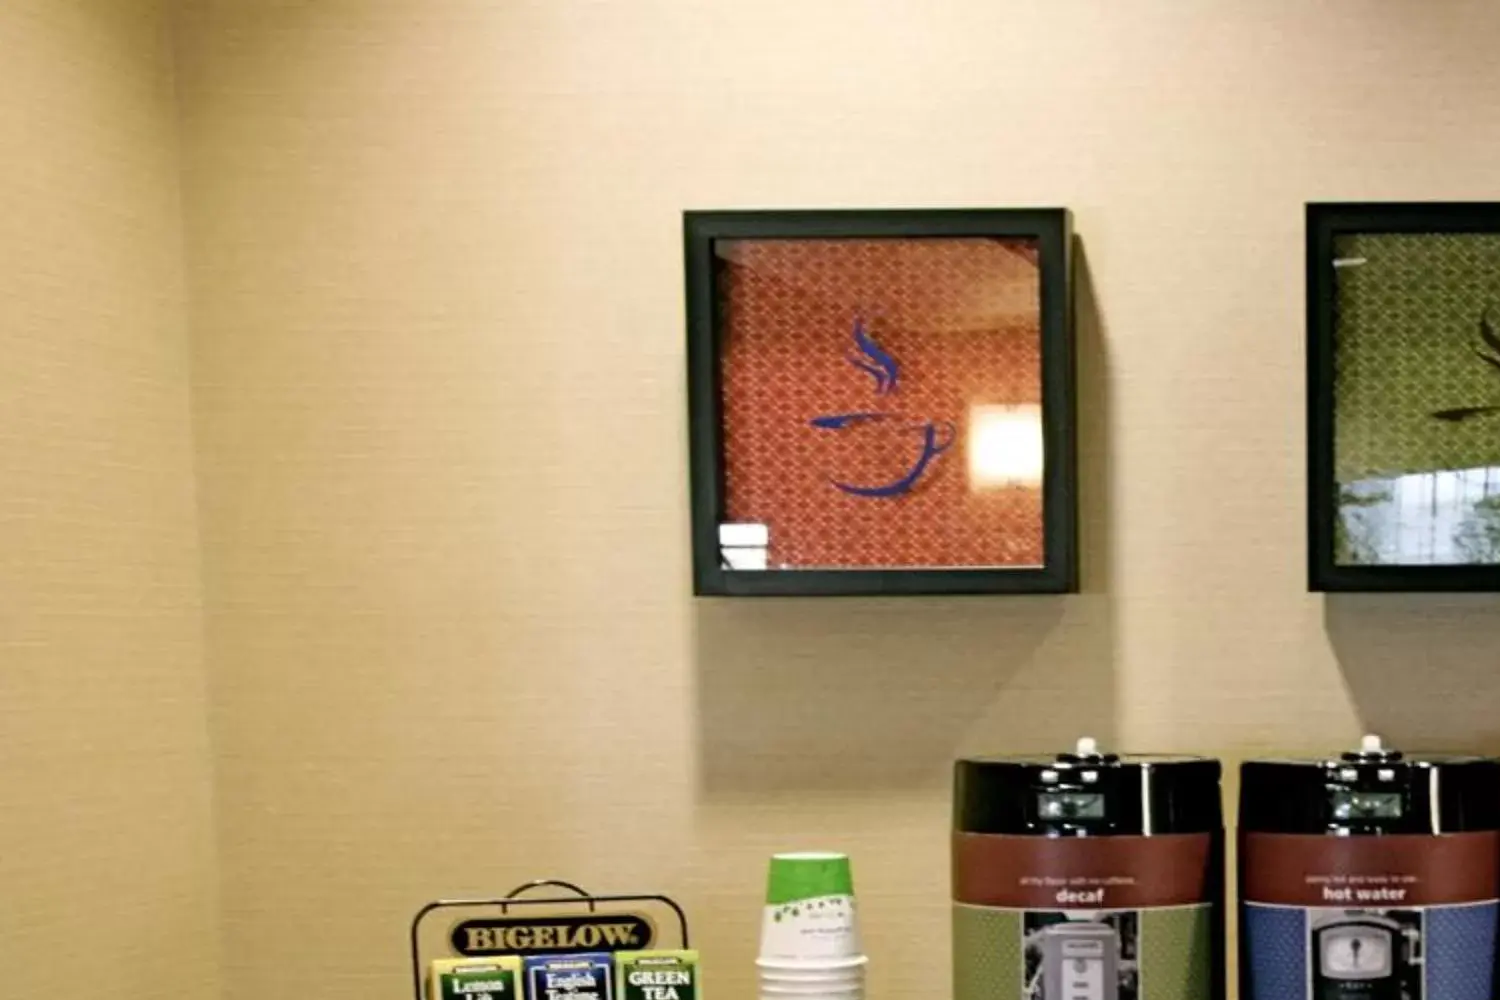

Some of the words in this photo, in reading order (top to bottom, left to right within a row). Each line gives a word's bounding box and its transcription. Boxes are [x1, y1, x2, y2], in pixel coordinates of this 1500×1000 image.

[1055, 888, 1104, 903] decaf
[1322, 886, 1352, 901] hot
[1357, 887, 1407, 901] water
[464, 922, 638, 950] BIGELOW
[452, 978, 504, 994] Lemon
[545, 971, 597, 991] English
[628, 971, 691, 987] GREEN
